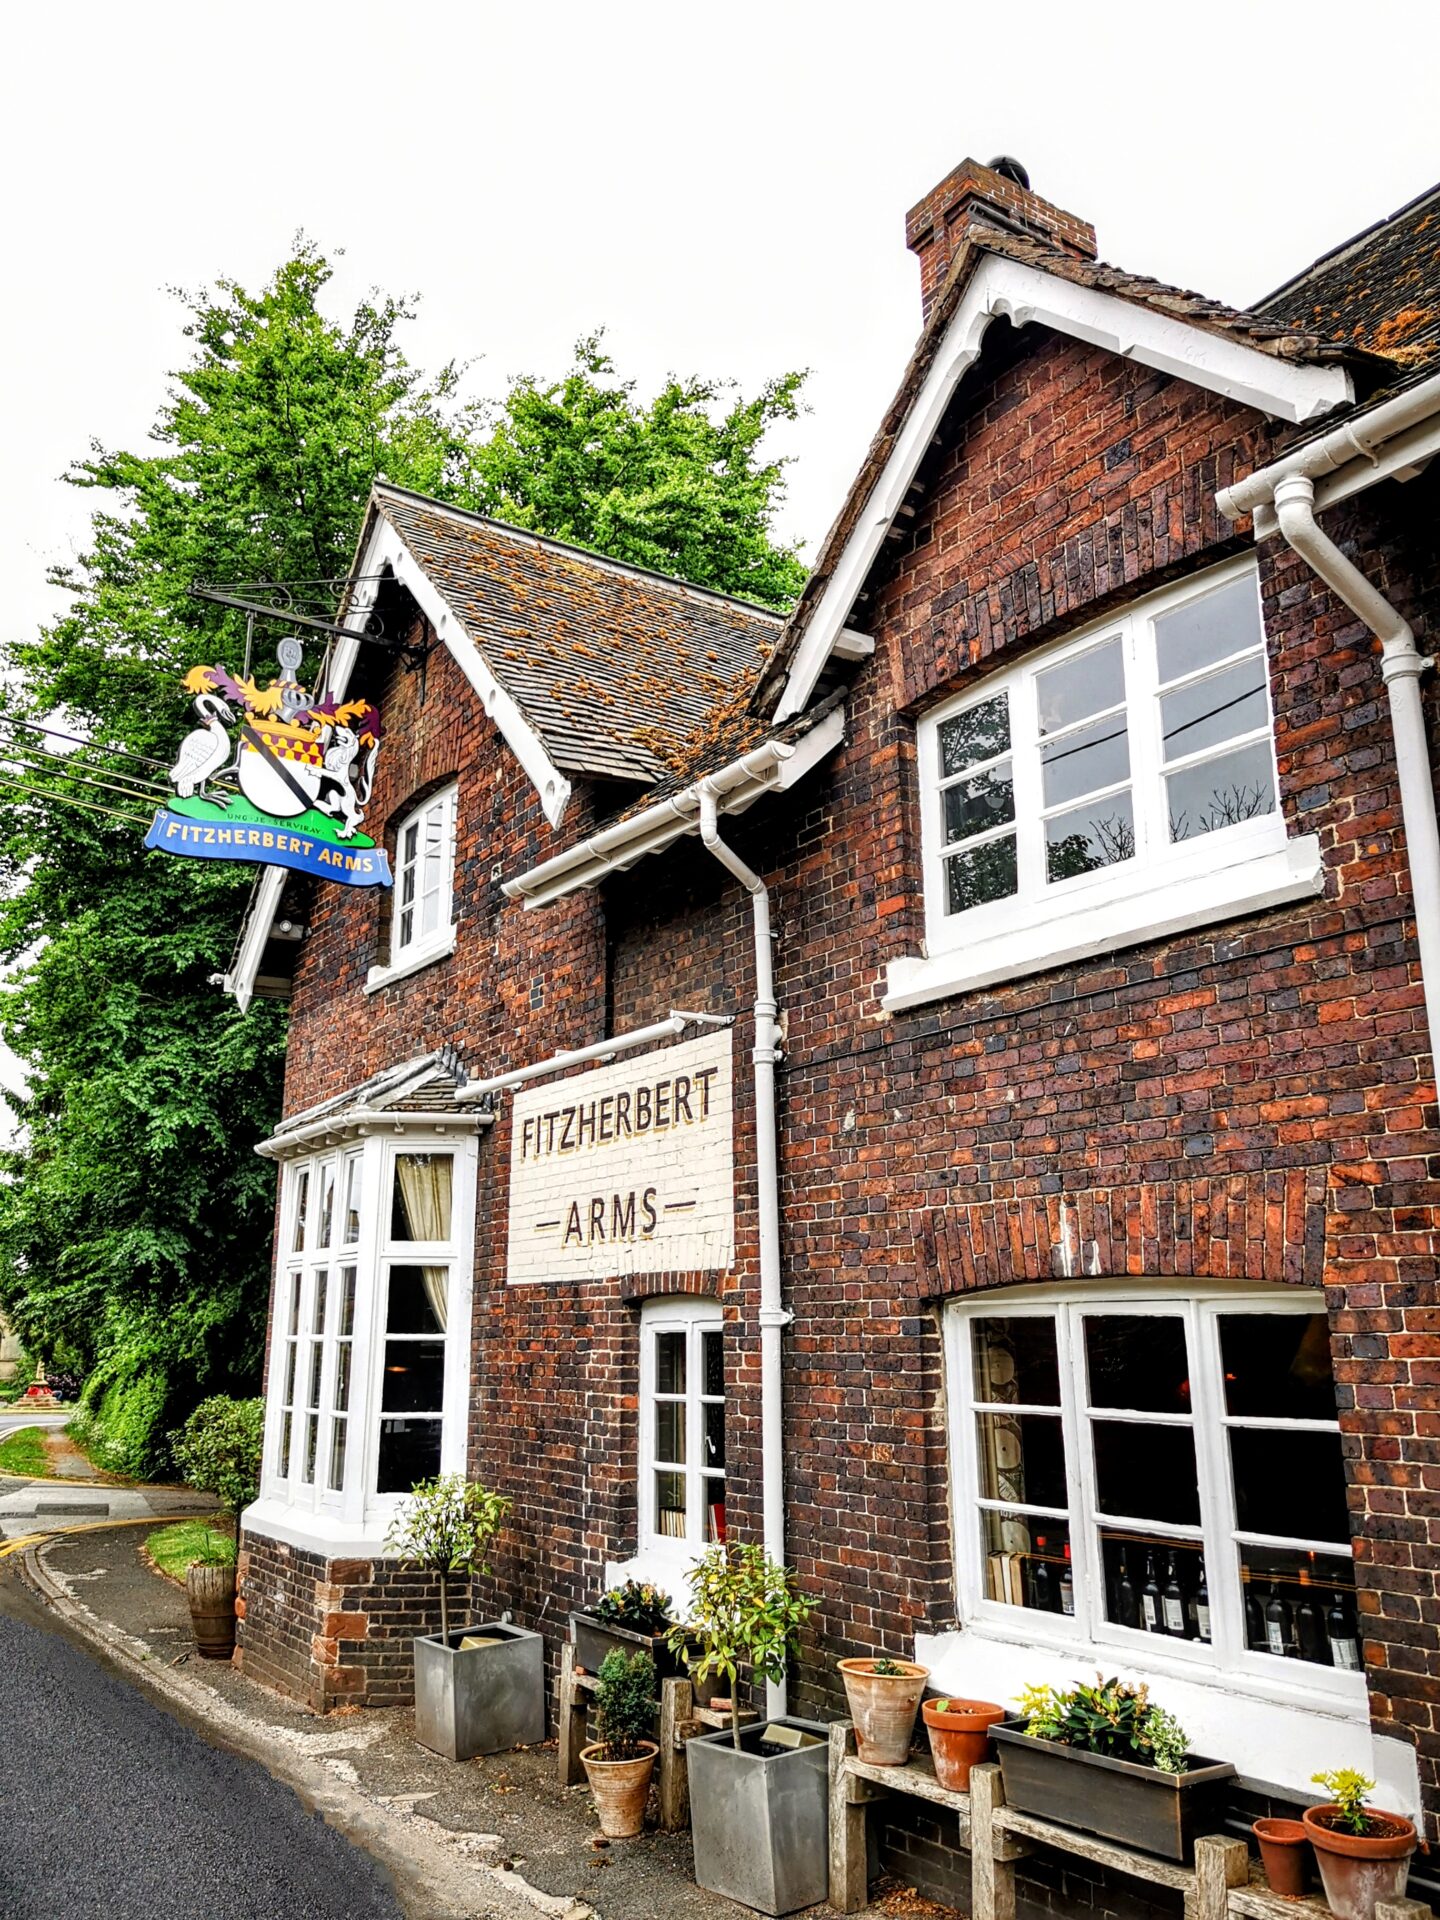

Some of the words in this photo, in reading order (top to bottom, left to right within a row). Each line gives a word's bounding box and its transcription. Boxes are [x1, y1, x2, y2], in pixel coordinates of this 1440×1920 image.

[166, 822, 314, 856] FITZHERBERT
[317, 847, 374, 873] ARMS
[273, 818, 321, 835] SERVIRAY
[521, 1066, 719, 1161] FITZHERBERT
[563, 1186, 658, 1245] ARMS
